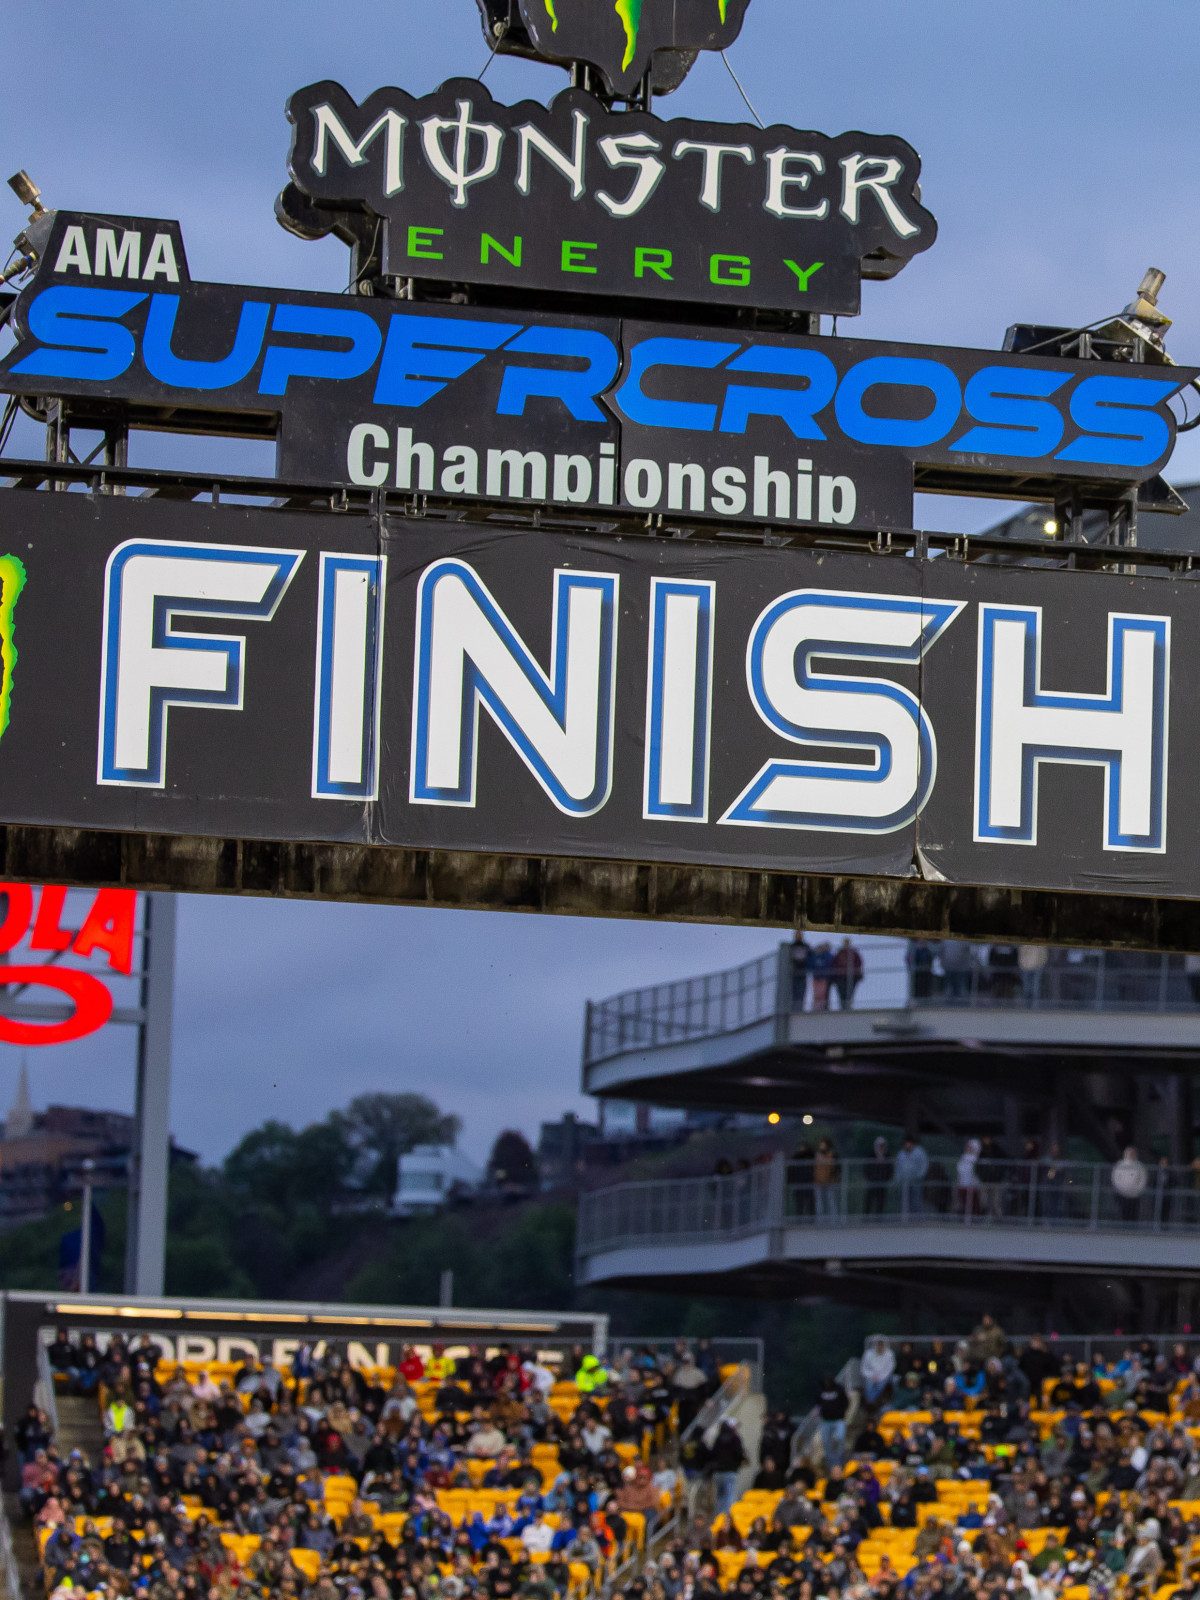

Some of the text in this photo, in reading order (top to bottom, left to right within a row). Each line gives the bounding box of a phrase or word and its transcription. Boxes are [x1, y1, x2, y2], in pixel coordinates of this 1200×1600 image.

[310, 99, 919, 237] MONSTER
[53, 225, 180, 283] AMA
[406, 226, 825, 292] ENERGY
[8, 285, 1180, 467] SUPERCROSS
[346, 422, 858, 525] Championship
[97, 538, 1172, 855] FINISH
